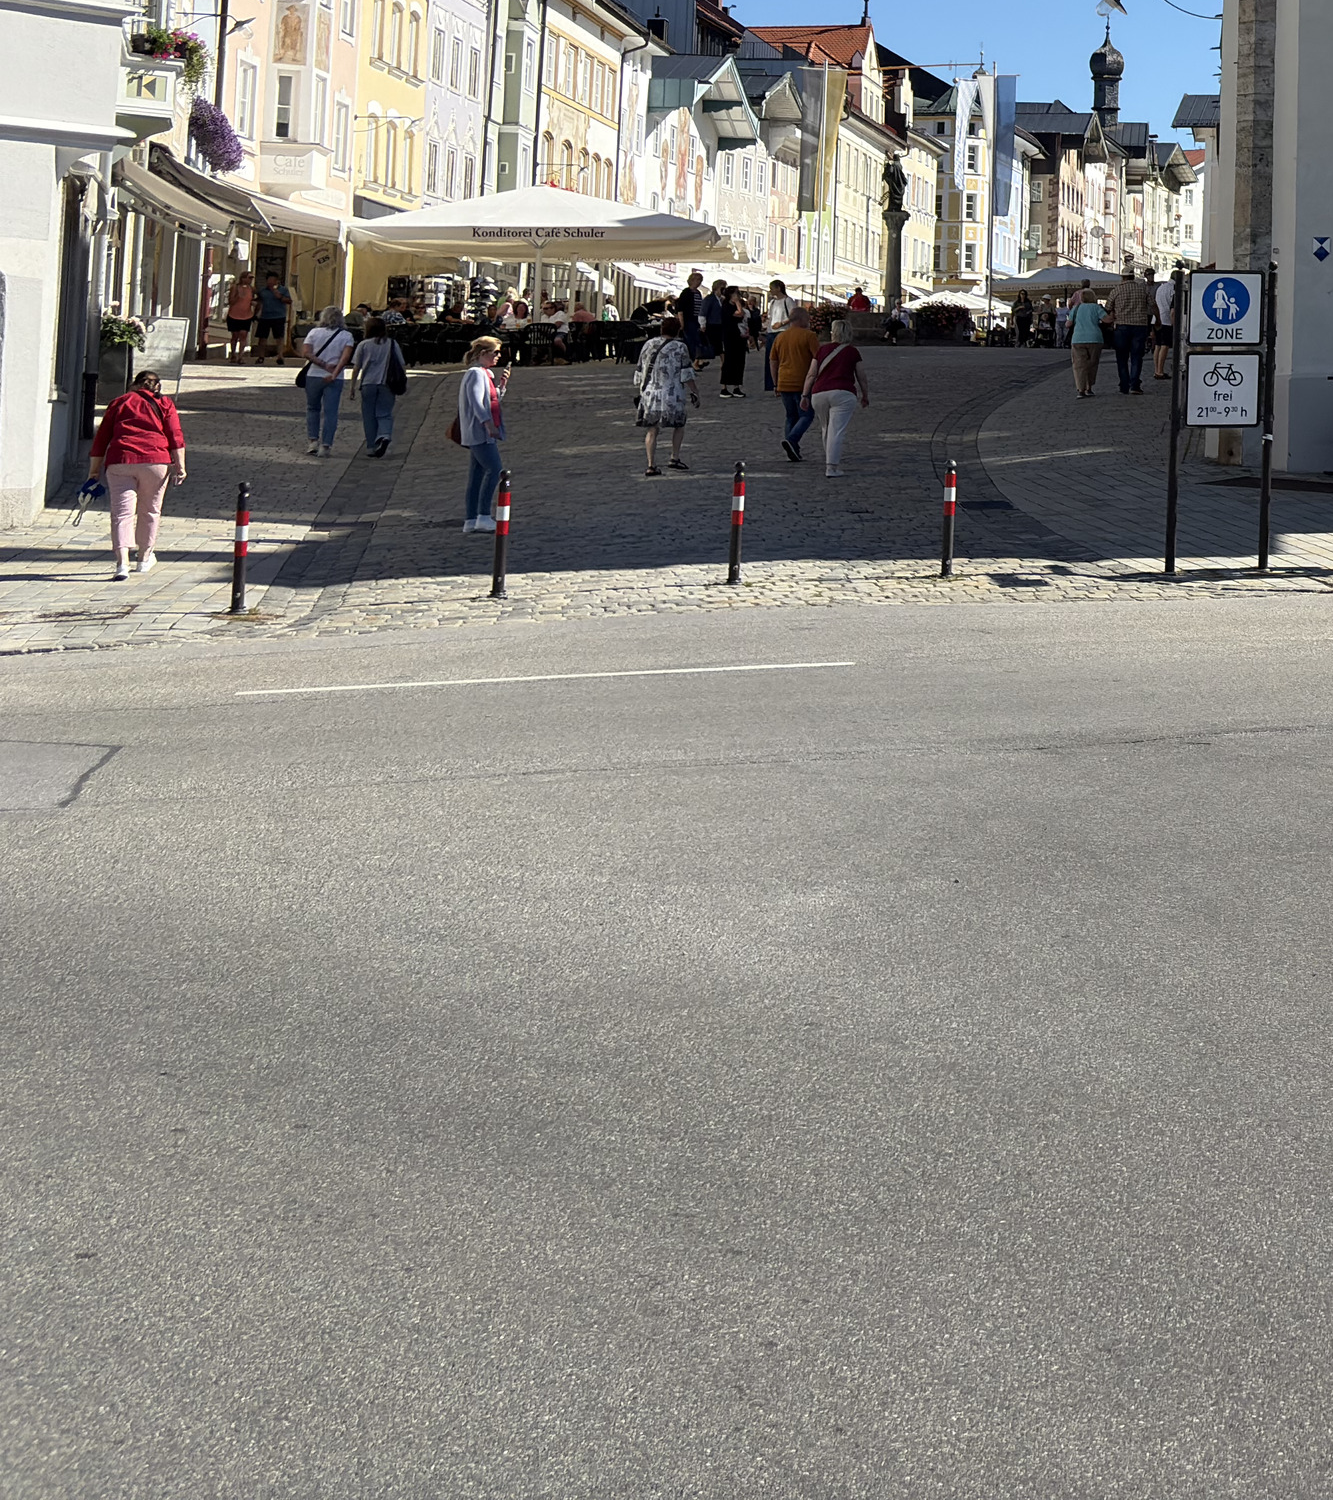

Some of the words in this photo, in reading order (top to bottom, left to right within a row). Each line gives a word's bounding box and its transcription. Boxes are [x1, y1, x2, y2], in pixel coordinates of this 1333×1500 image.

[472, 227, 532, 238] Konditorei
[535, 228, 561, 238] Café
[563, 227, 605, 238] Schuler
[1206, 328, 1243, 340] ZONE
[1213, 390, 1233, 401] frei
[1240, 407, 1247, 418] h
